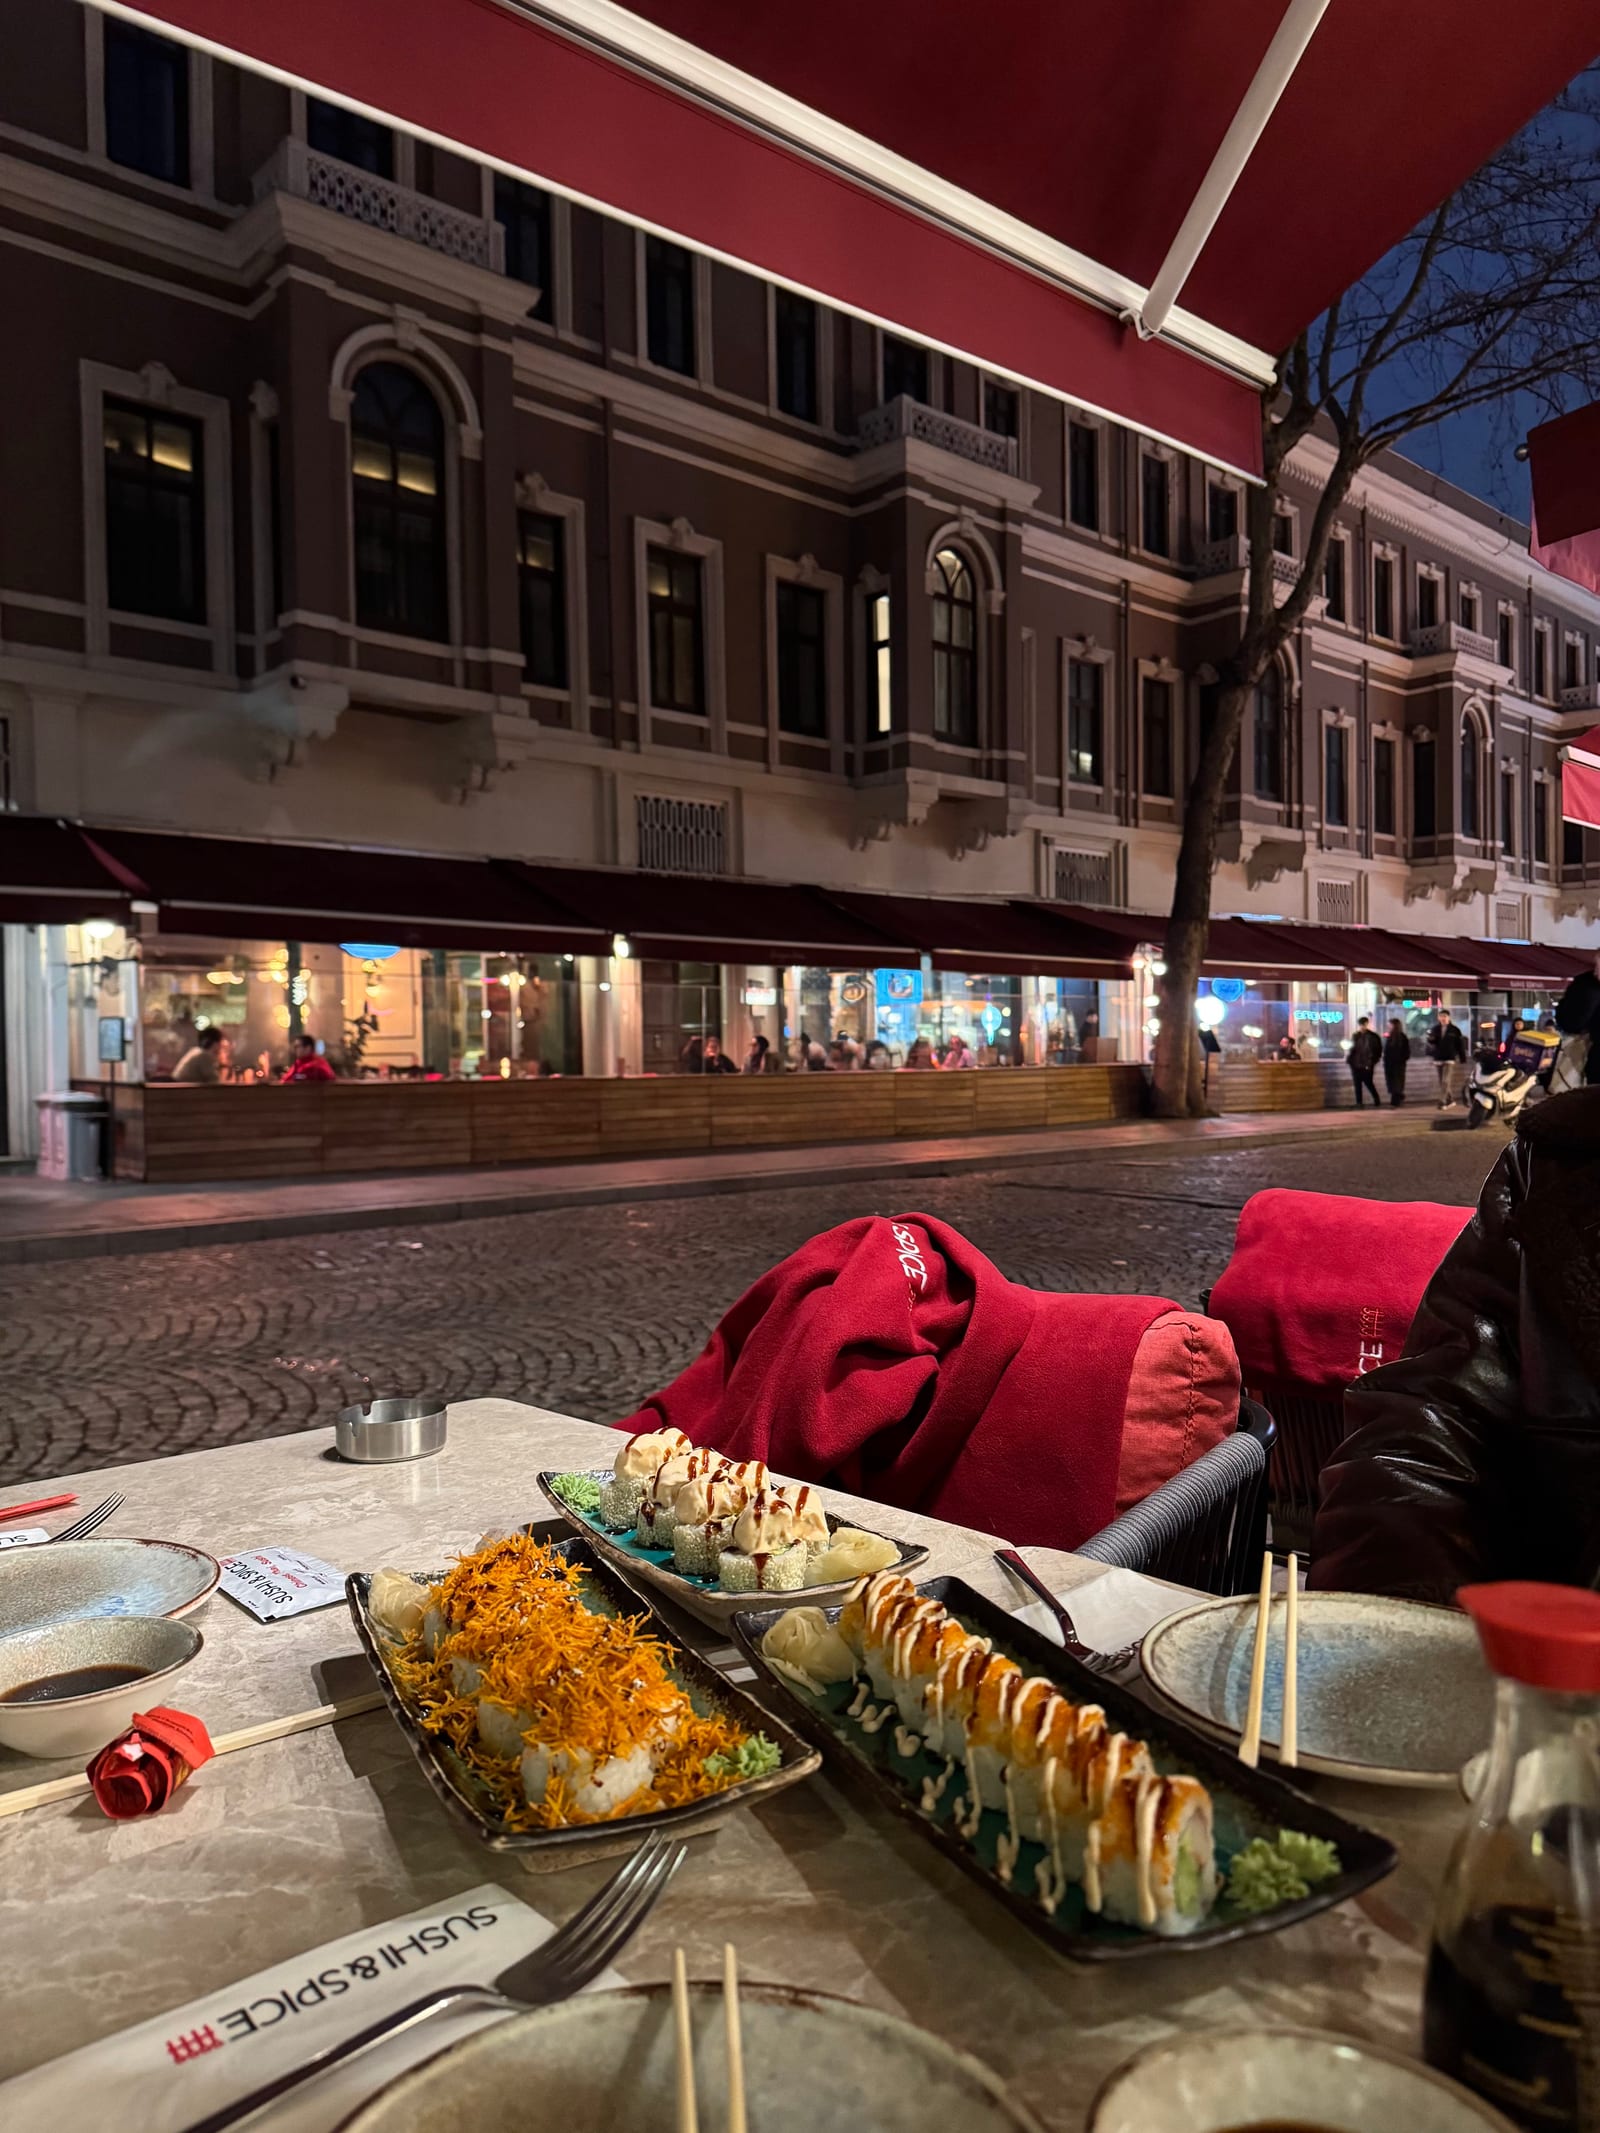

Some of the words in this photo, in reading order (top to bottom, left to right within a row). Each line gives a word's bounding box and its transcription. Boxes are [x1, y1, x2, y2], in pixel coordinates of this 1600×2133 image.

[891, 1221, 928, 1291] SPICE
[0, 1534, 28, 1545] SU
[224, 1561, 259, 1581] SPICE
[250, 1574, 266, 1585] &
[254, 1580, 293, 1604] SUSHI
